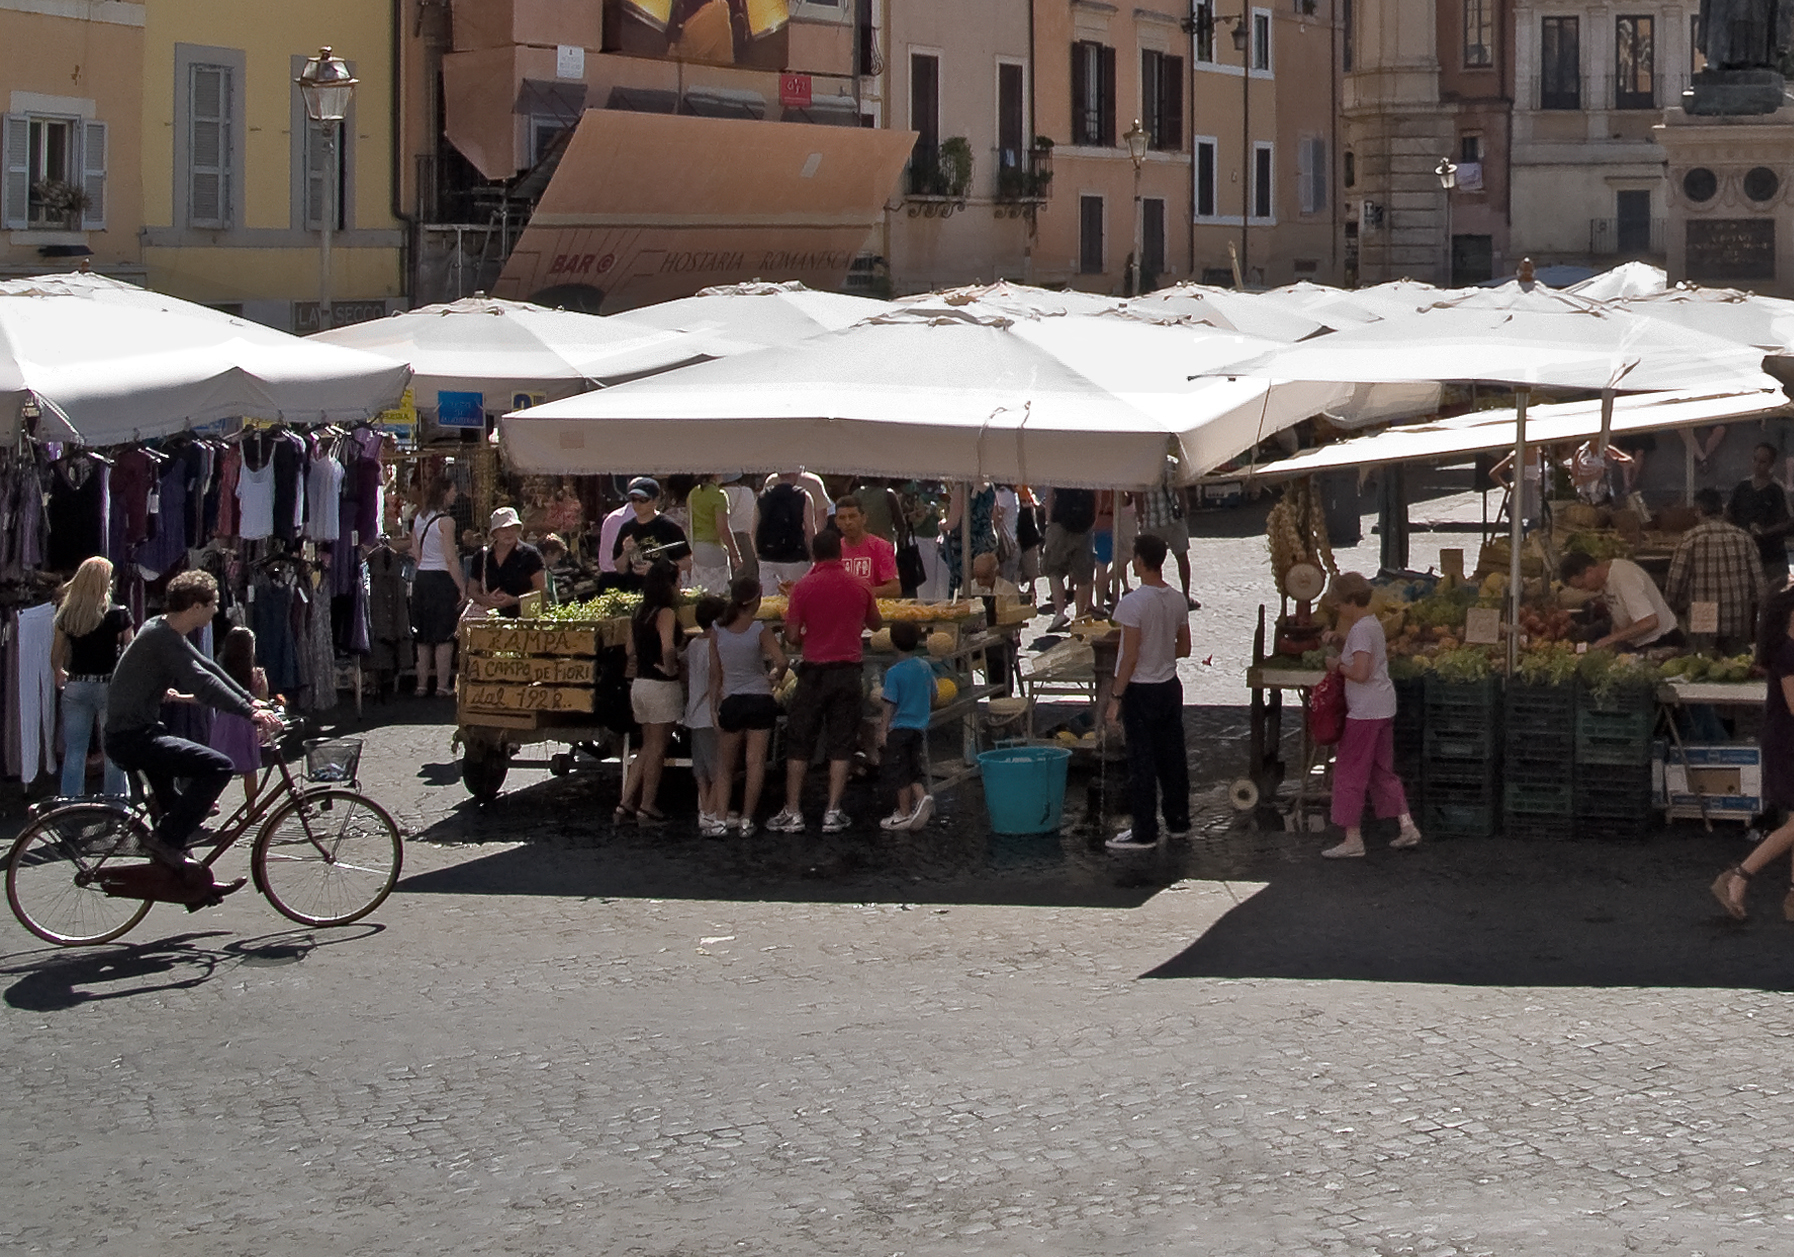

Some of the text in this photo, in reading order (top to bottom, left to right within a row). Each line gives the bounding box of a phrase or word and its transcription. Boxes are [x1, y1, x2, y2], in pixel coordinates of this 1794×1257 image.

[548, 253, 596, 274] BAR
[659, 251, 744, 273] HOSTARIA
[467, 660, 480, 678] A
[535, 666, 551, 682] DE
[470, 688, 505, 708] dal
